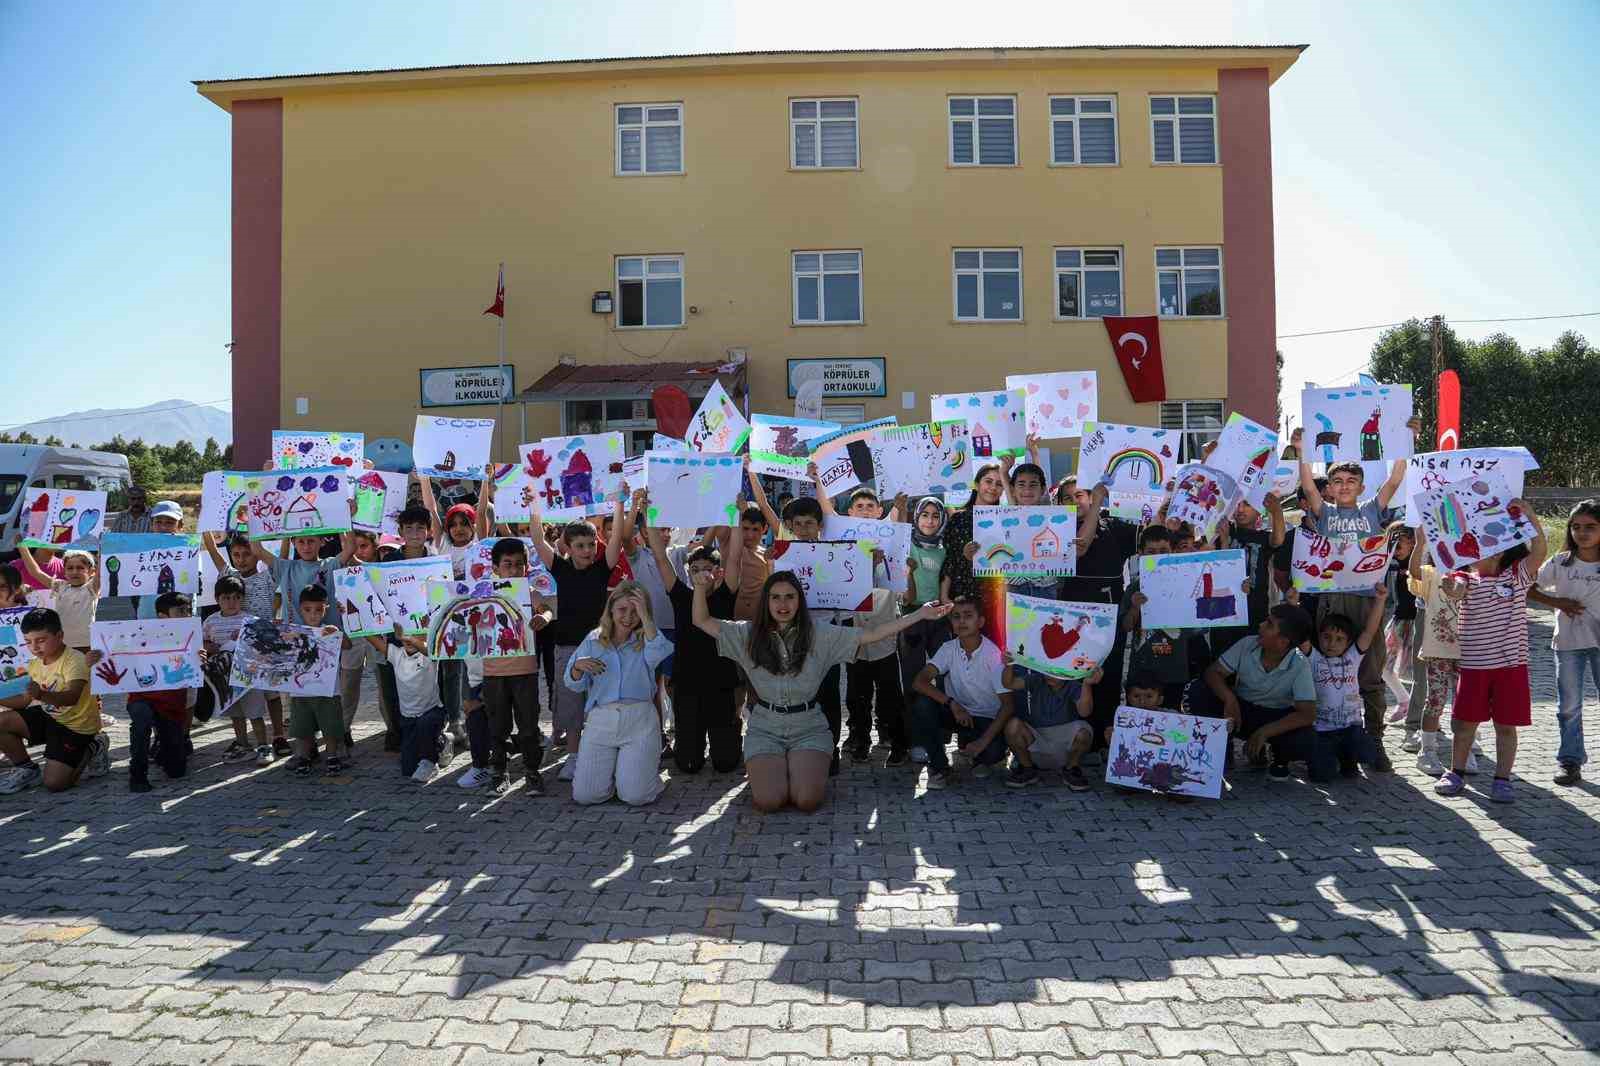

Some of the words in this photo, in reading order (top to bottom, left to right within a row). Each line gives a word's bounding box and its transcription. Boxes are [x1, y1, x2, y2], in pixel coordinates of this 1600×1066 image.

[824, 368, 870, 379] KÖPRÜLER
[824, 382, 876, 391] ORTAOKULU
[137, 547, 199, 562] EYMEN
